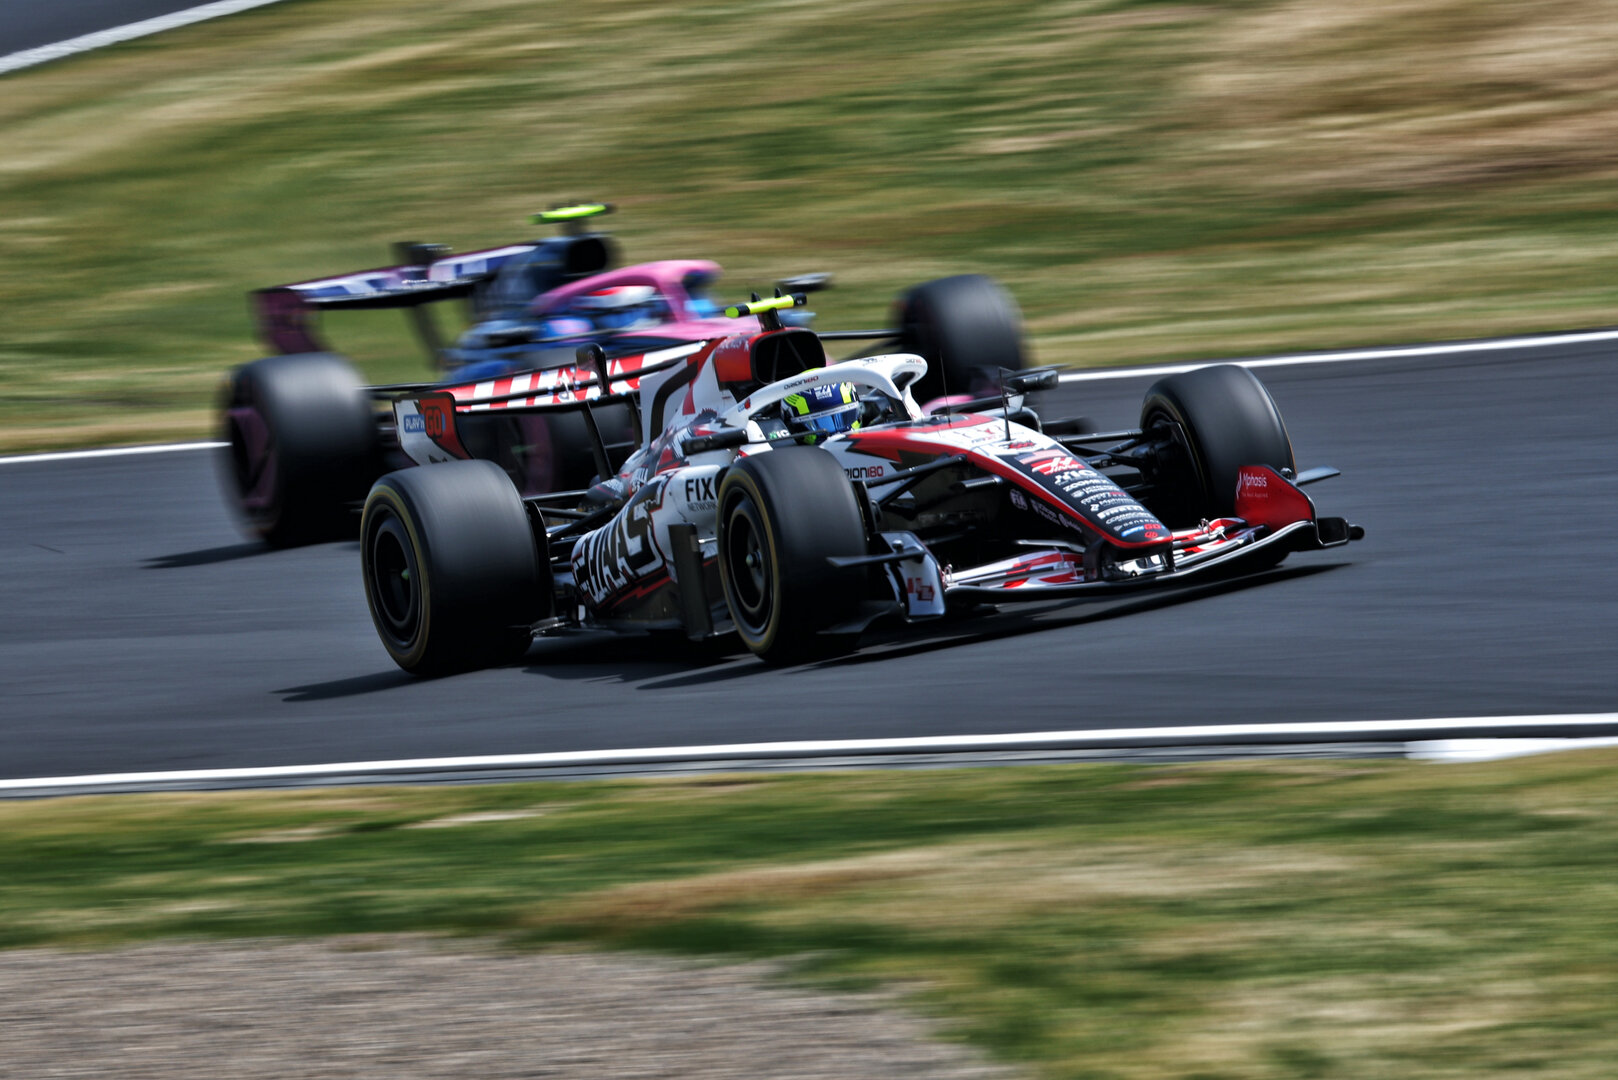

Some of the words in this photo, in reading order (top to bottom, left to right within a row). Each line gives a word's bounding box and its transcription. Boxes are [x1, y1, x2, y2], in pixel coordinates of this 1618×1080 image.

[425, 407, 442, 438] GO
[686, 477, 714, 502] FIX
[1243, 472, 1268, 490] Mphasis
